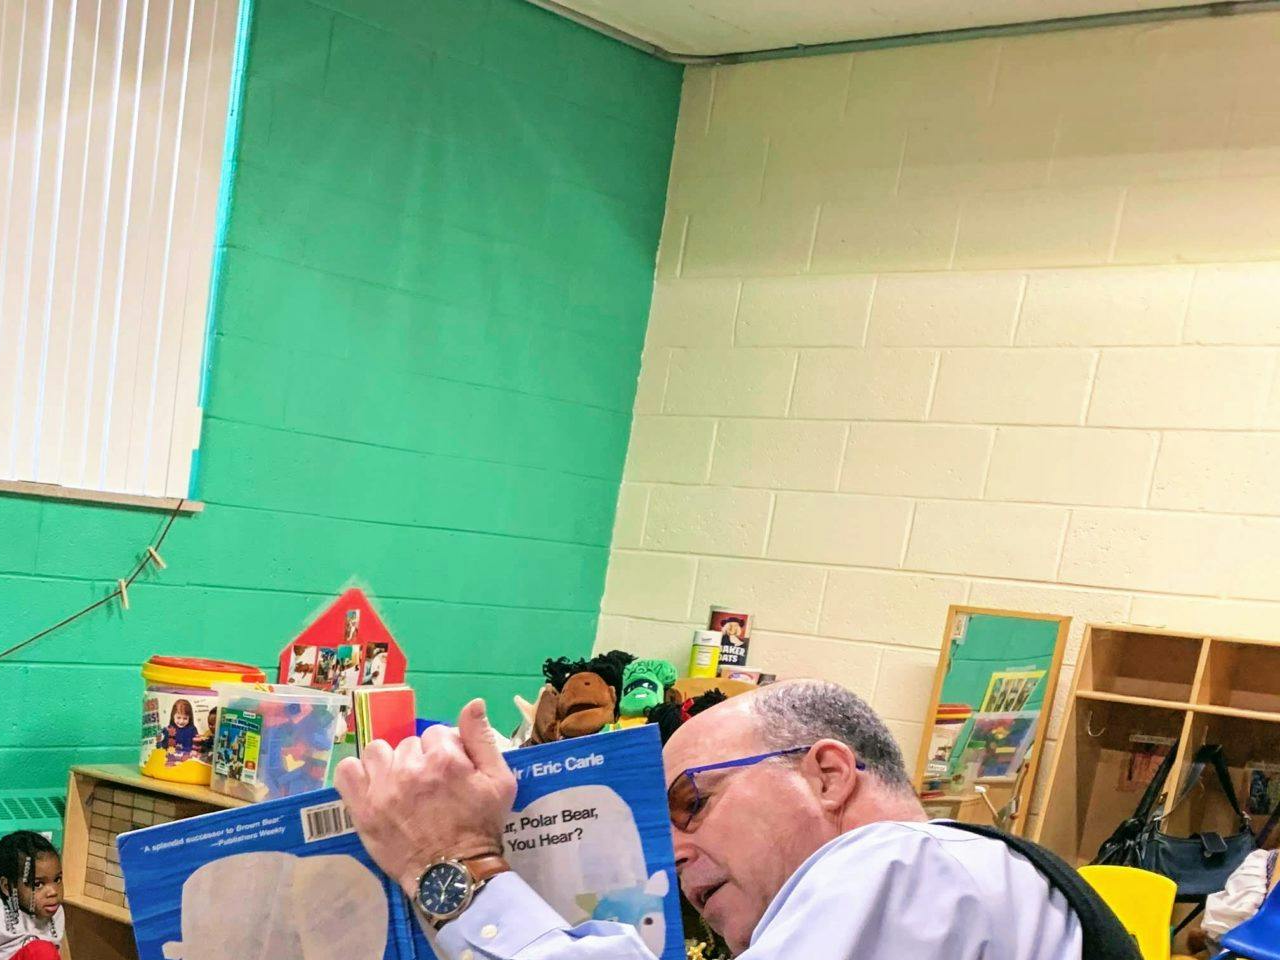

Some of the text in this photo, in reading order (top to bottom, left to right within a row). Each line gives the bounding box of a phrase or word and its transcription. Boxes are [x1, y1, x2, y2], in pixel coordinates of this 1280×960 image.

[532, 762, 563, 778] Eric
[565, 753, 605, 771] Carle
[520, 814, 558, 831] Polar
[561, 807, 599, 823] Bear,
[152, 837, 185, 852] splendid
[225, 826, 234, 835] to
[236, 820, 261, 833] Brown
[259, 826, 287, 840] Weekly
[507, 828, 584, 852] You Hear?
